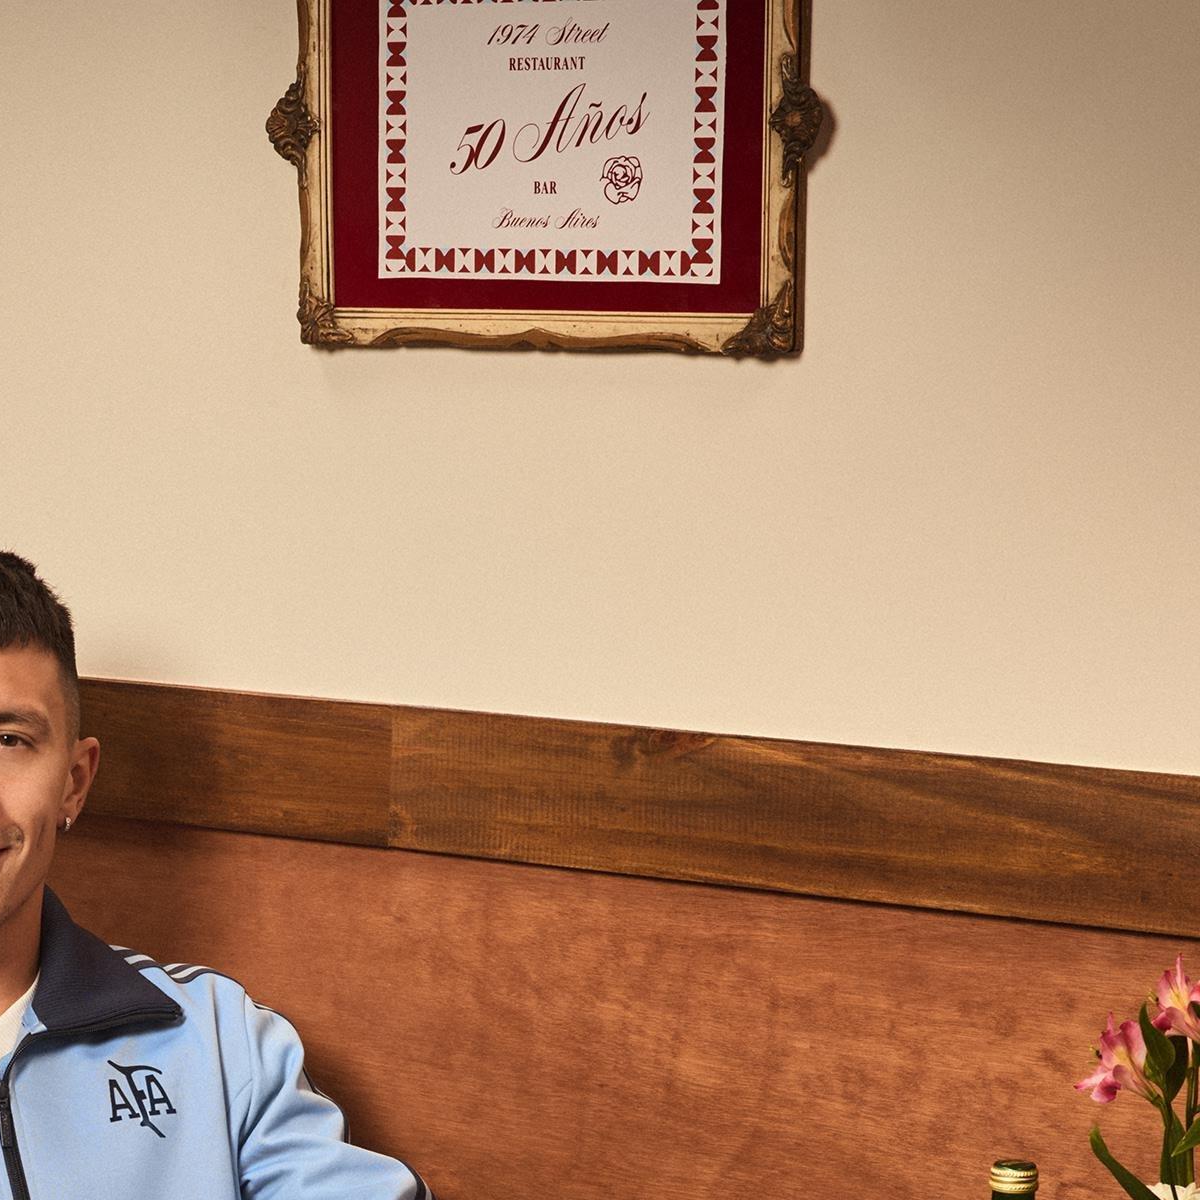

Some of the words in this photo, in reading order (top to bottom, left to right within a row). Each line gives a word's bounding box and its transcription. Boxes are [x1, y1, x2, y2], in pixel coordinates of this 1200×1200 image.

[487, 23, 540, 46] 1974
[545, 16, 610, 46] Street
[509, 56, 586, 71] RESTAURANT
[450, 118, 506, 175] 50
[512, 82, 650, 163] Años
[533, 181, 557, 194] BAR
[491, 207, 551, 229] Buenos
[555, 207, 600, 230] Aires
[107, 1059, 177, 1138] AFA
